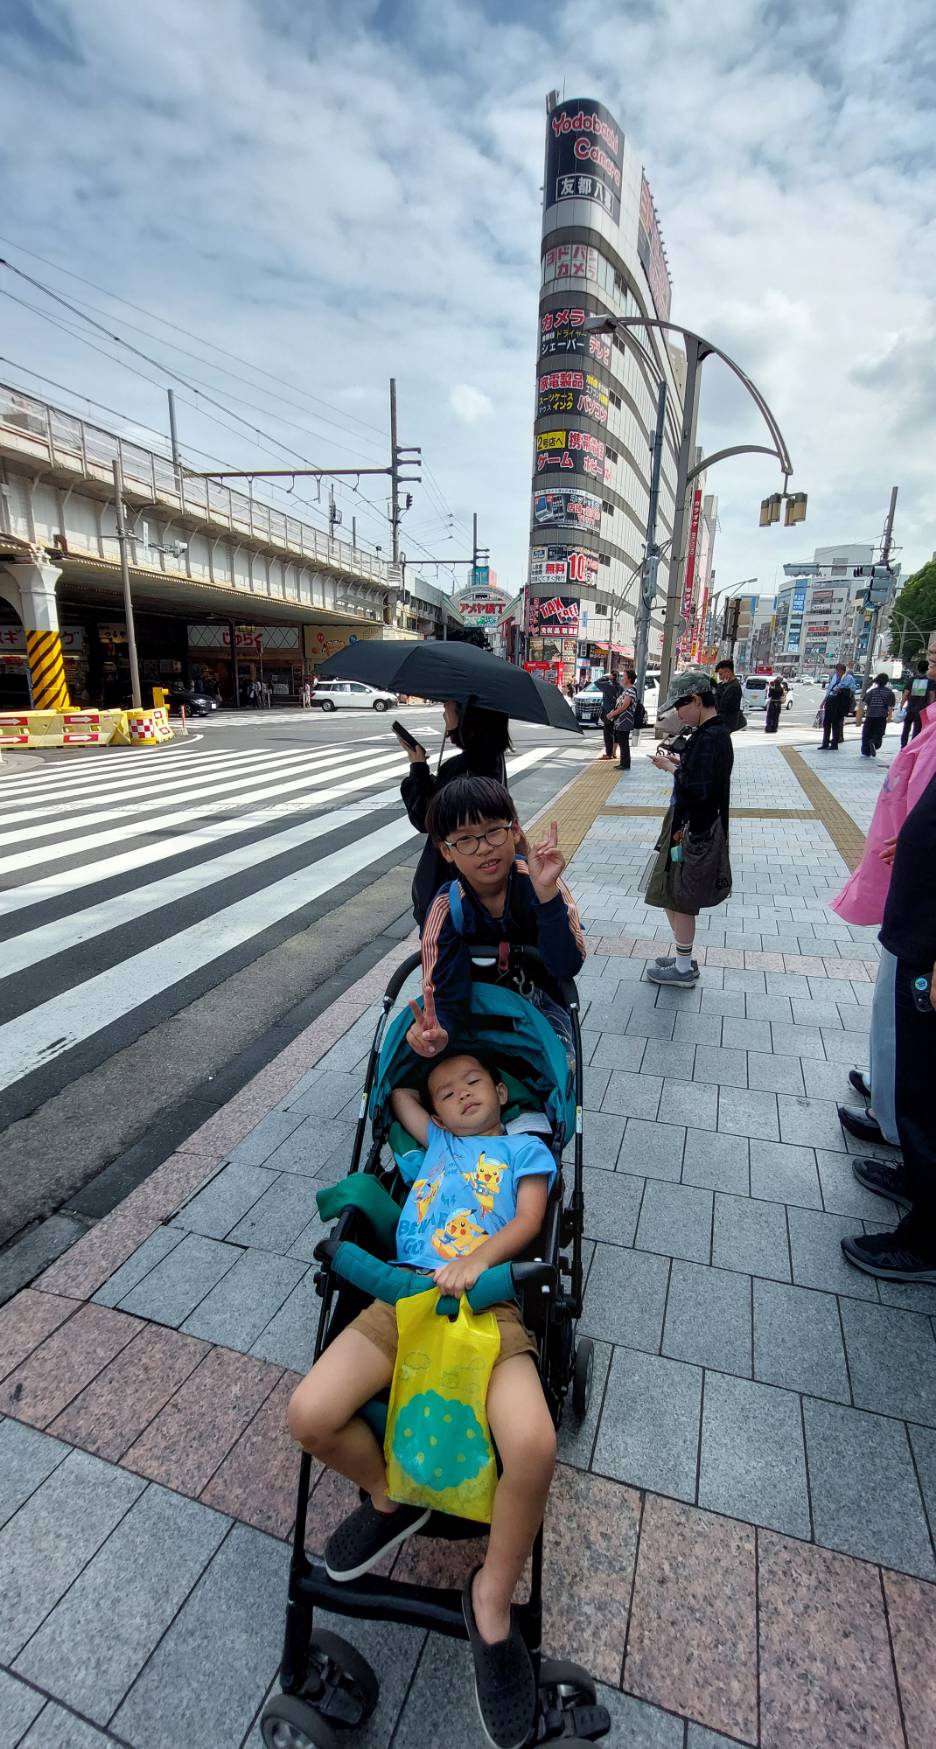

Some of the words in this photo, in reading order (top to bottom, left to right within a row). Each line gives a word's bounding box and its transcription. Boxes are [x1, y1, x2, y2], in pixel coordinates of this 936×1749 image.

[542, 309, 585, 332] カメラ
[537, 436, 563, 450] 2号店へ
[537, 452, 574, 472] ゲーム
